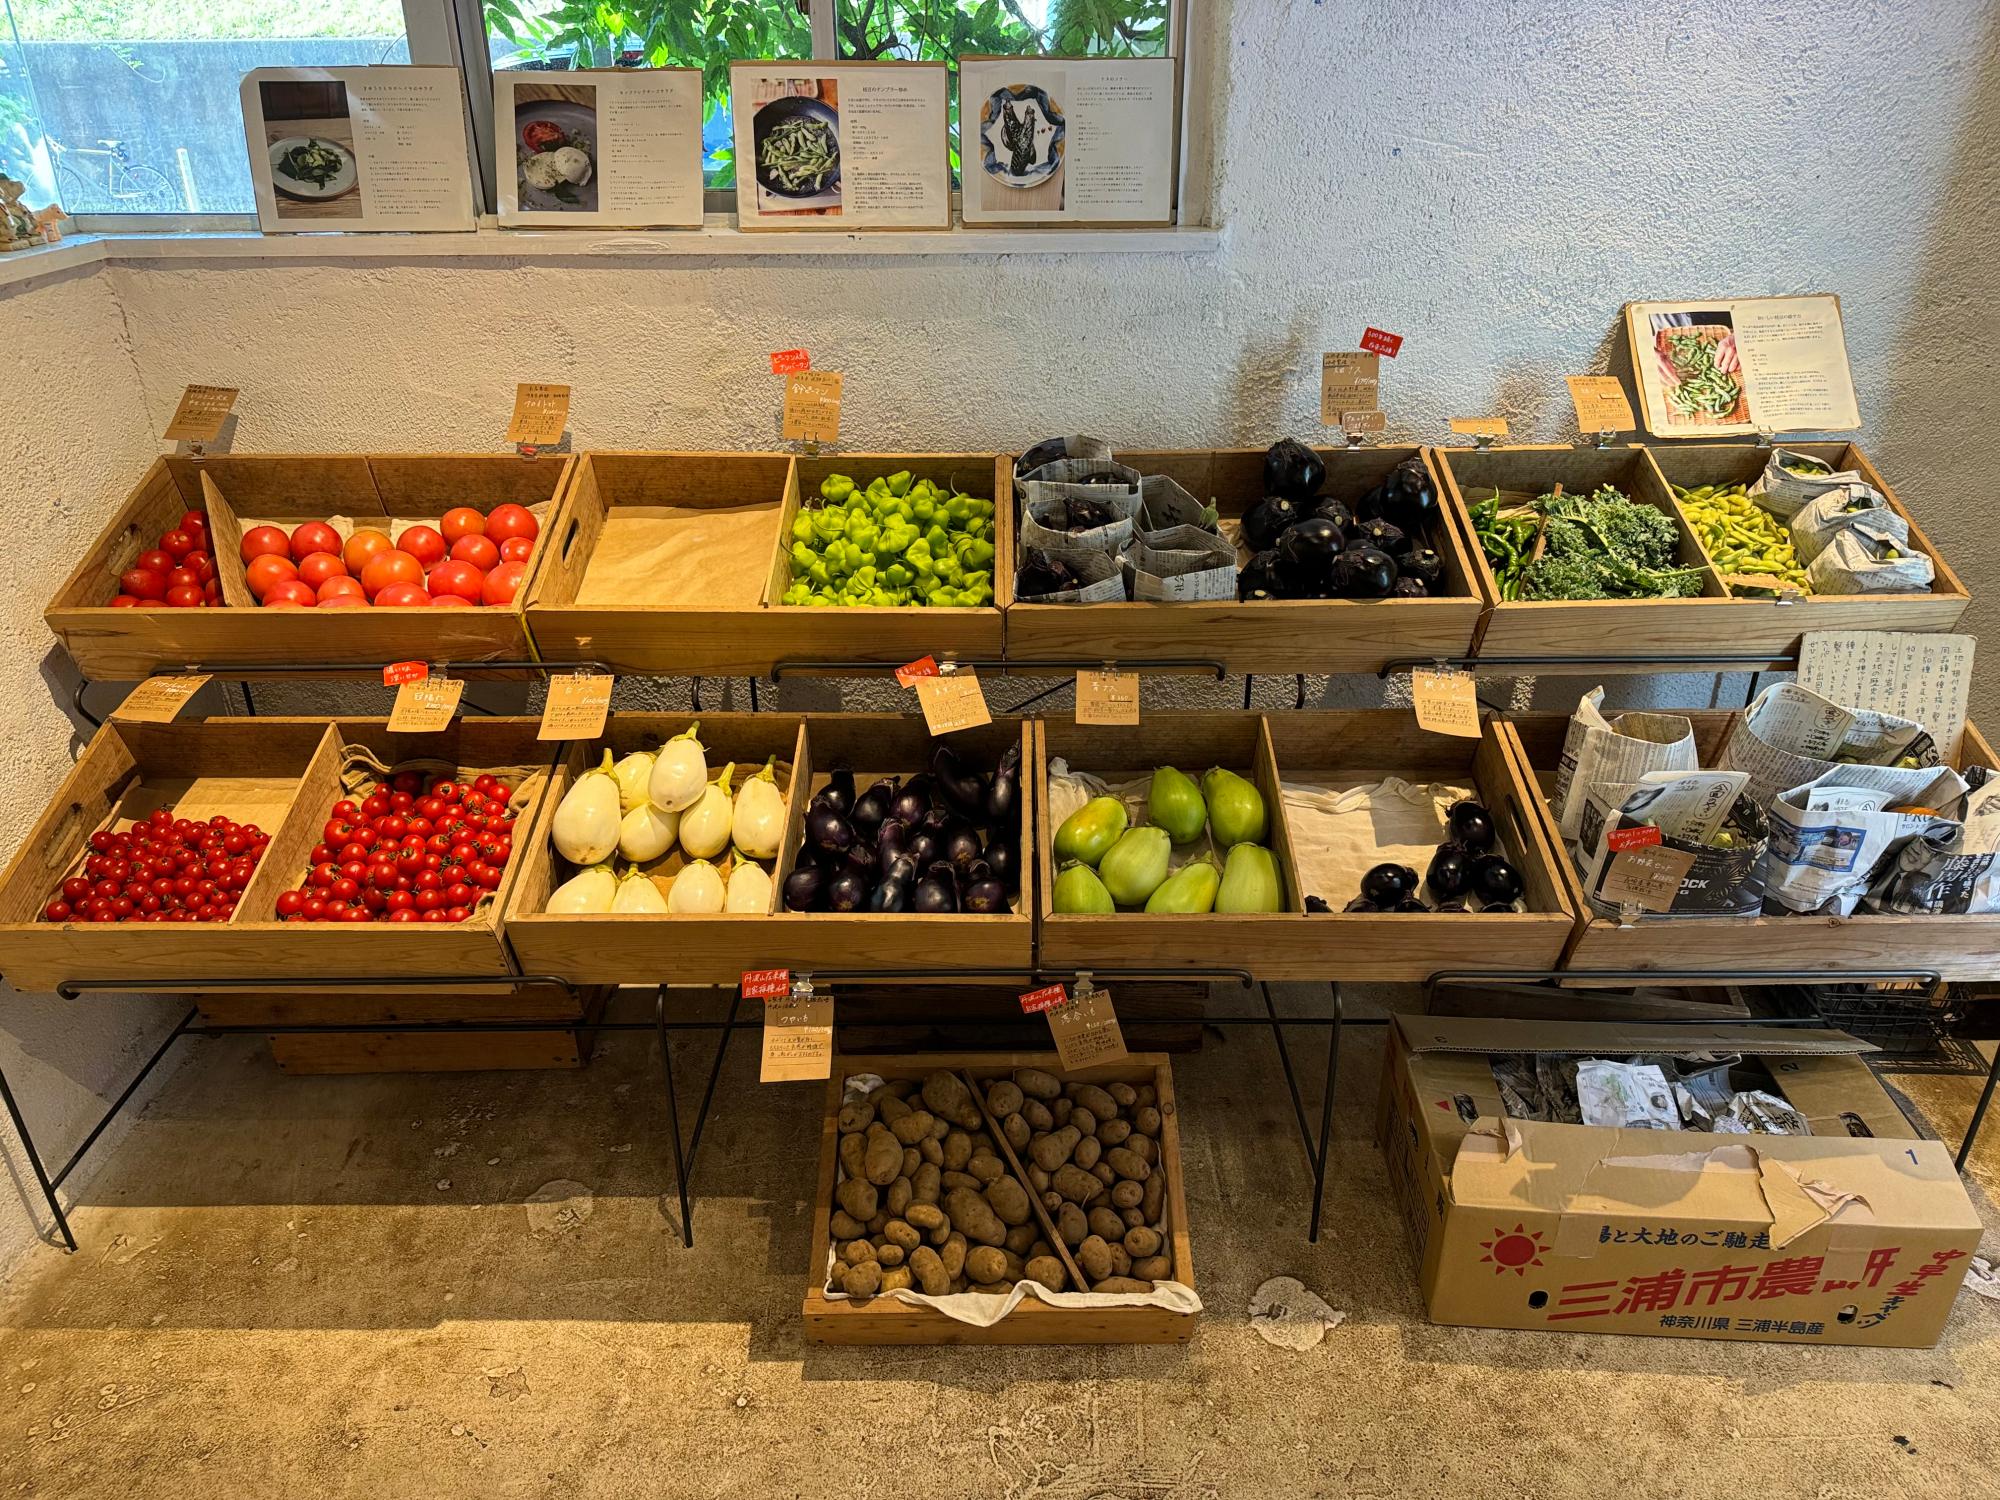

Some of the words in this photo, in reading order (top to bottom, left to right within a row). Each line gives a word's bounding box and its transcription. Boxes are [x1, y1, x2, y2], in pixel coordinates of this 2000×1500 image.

[1905, 1148, 1919, 1166] 1
[1659, 1315, 1730, 1330] 神奈川県
[1734, 1318, 1825, 1337] 三浦半島産
